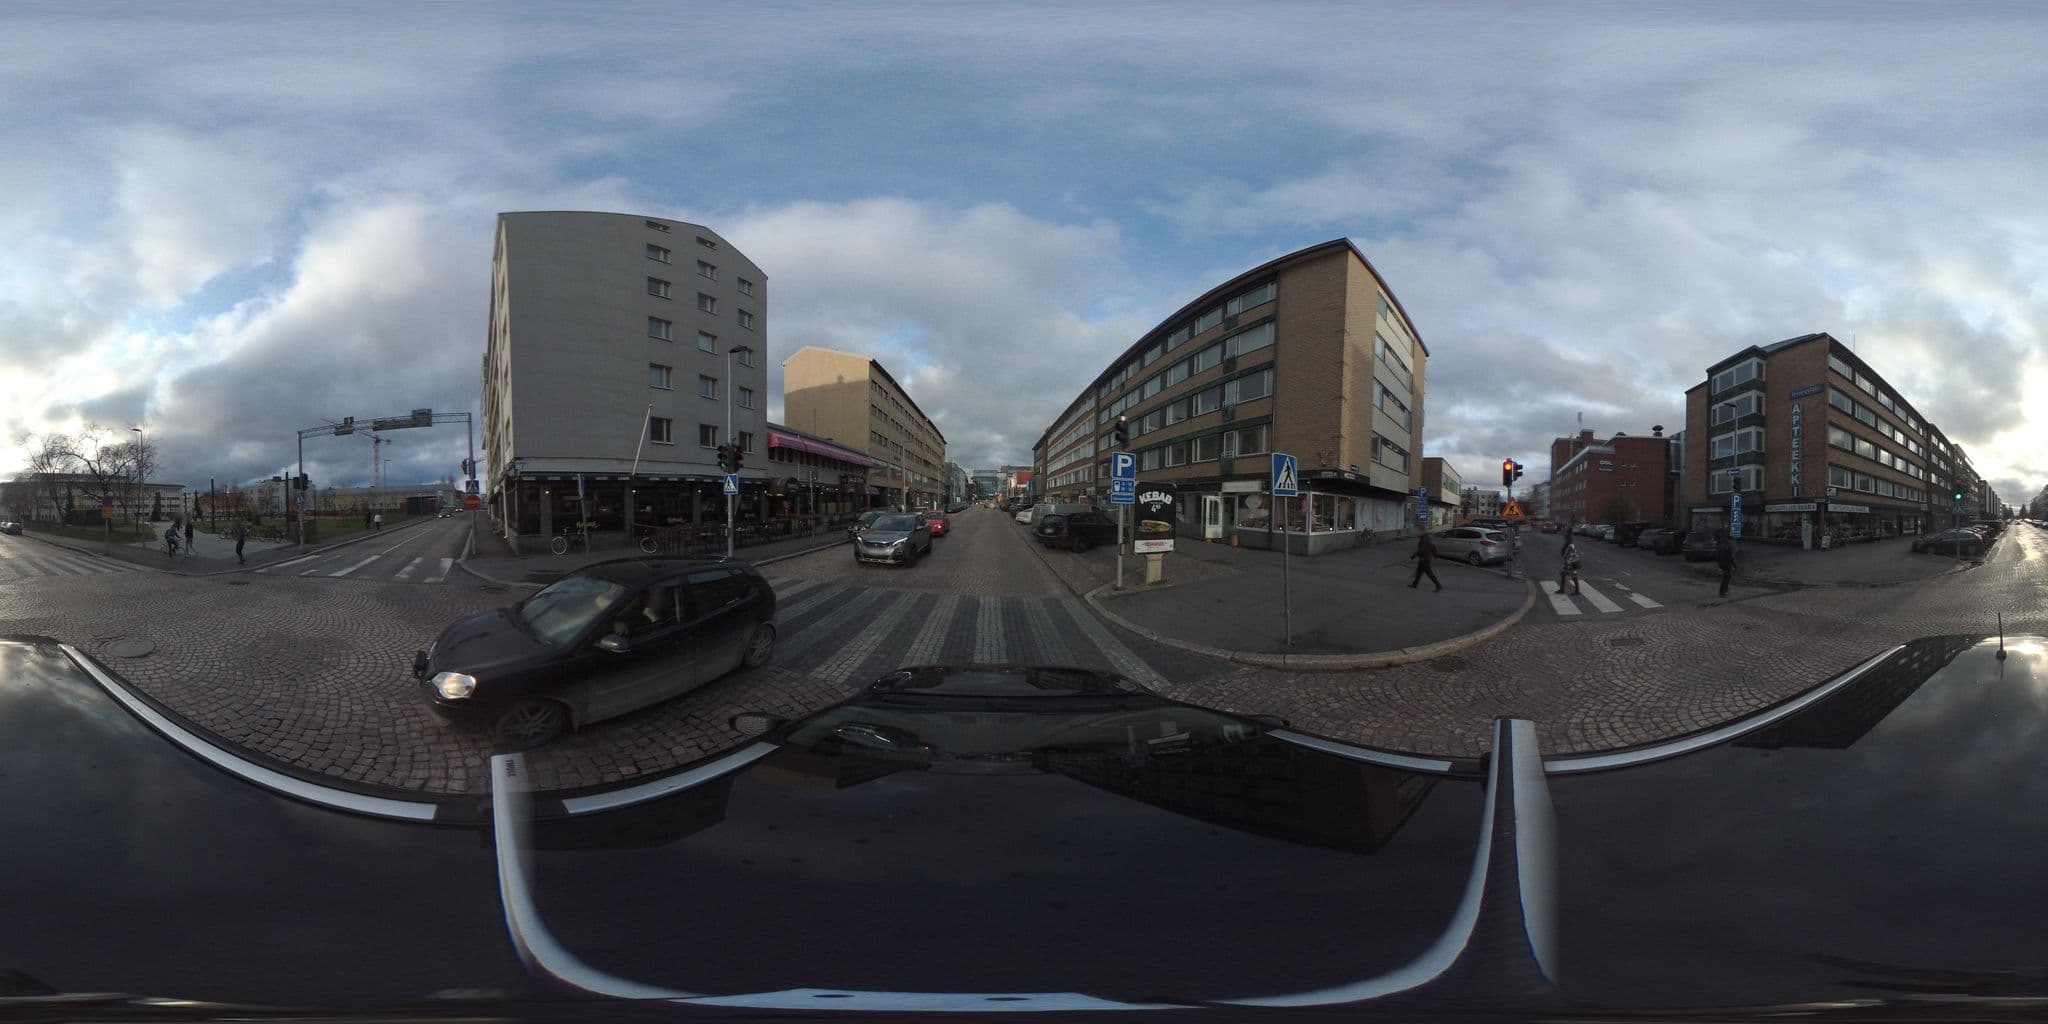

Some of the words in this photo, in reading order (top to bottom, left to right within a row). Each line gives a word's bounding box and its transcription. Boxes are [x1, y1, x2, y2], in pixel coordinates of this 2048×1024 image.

[1792, 405, 1800, 496] APTEEKKI
[1117, 454, 1133, 476] P
[1138, 491, 1173, 505] KEBAB
[1420, 487, 1426, 496] P
[1734, 495, 1740, 507] P
